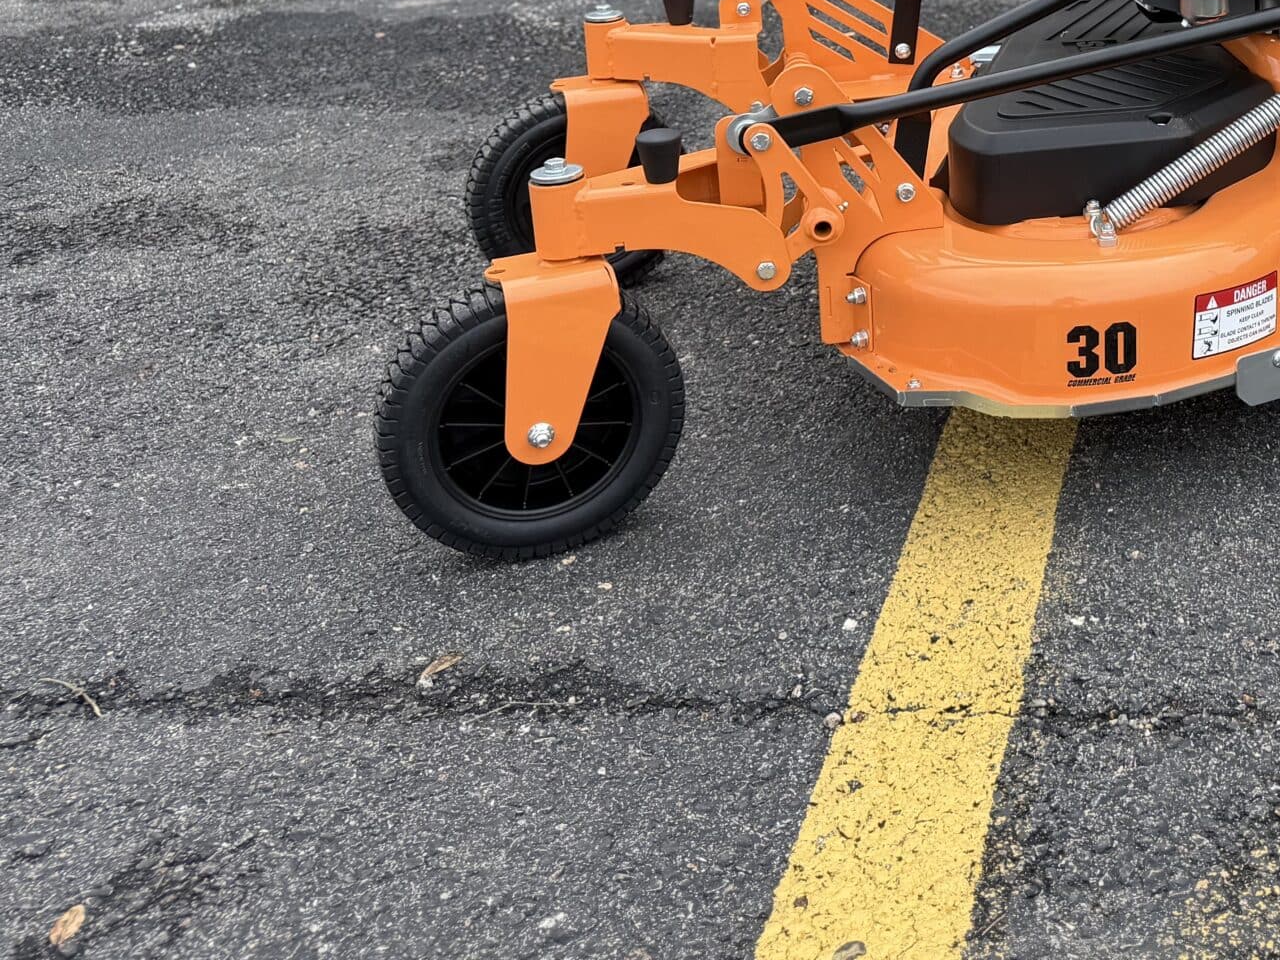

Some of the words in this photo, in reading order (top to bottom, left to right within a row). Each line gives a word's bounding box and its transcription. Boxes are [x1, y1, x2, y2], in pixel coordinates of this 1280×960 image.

[1234, 280, 1267, 302] DANGER
[1226, 302, 1255, 317] SPINNING
[1255, 293, 1274, 308] BLADES
[1239, 315, 1250, 323] KEEP
[1067, 322, 1137, 378] 30
[1067, 377, 1112, 387] COMMERCIAL
[1114, 373, 1136, 383] GRADE
